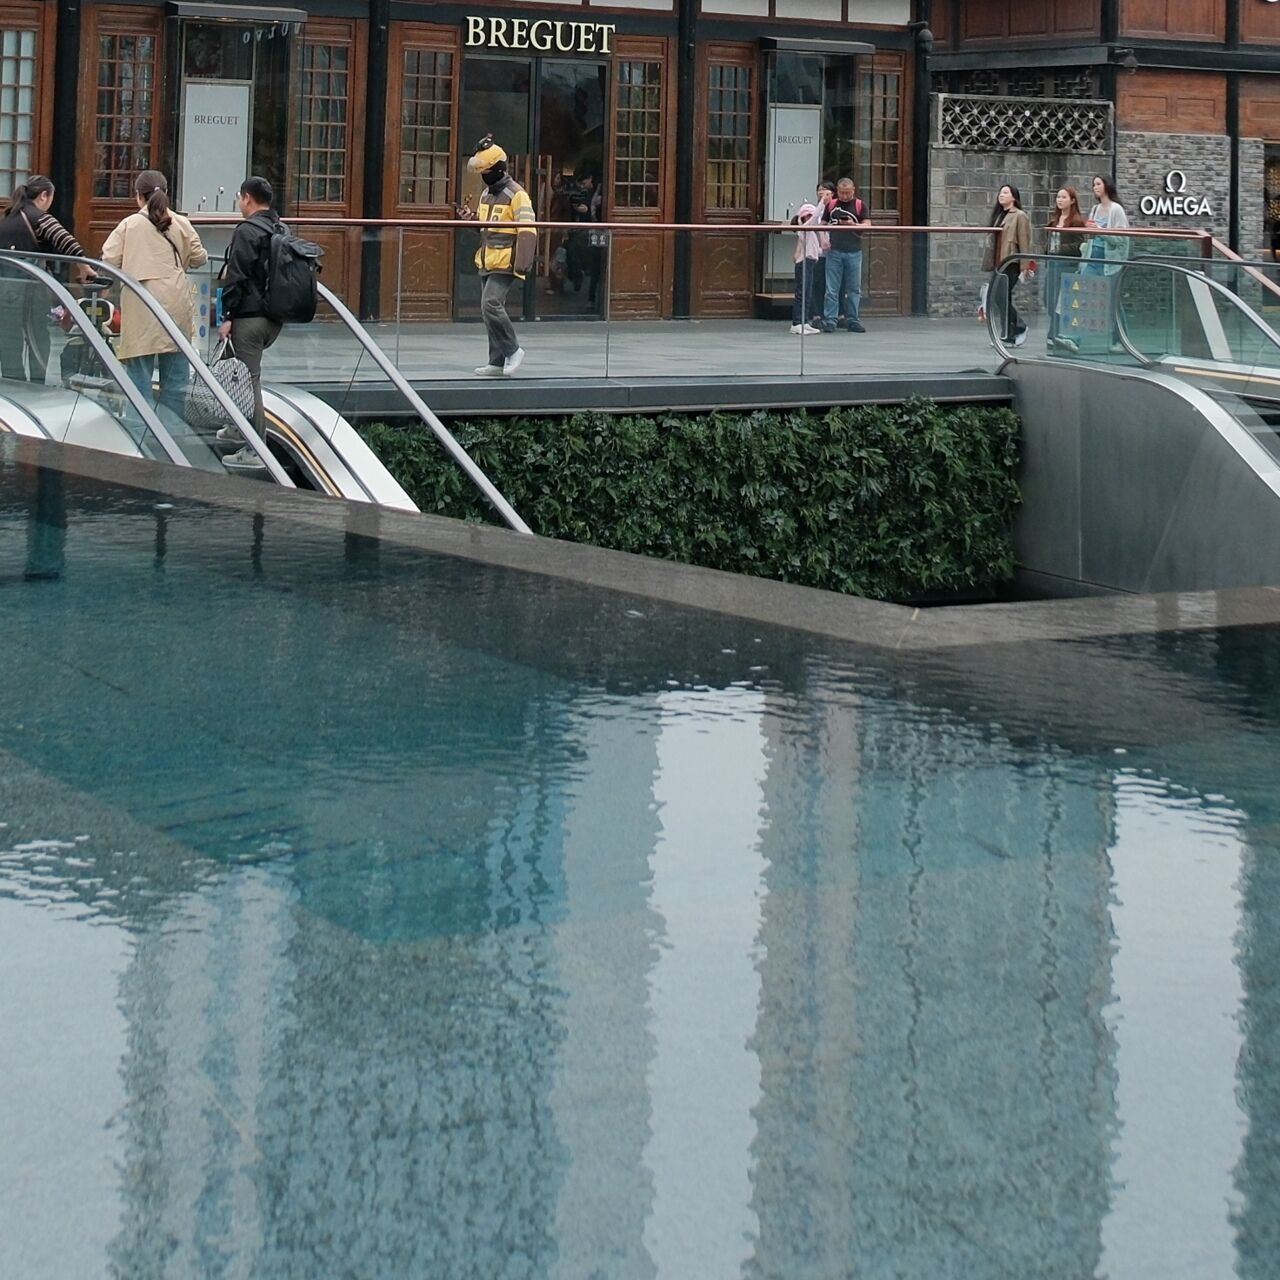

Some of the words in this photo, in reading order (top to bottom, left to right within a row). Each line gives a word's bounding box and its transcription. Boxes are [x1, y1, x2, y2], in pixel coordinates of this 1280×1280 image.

[465, 16, 616, 53] BREGUET
[194, 115, 239, 125] BREGUET
[777, 135, 813, 144] BREGUET
[1140, 195, 1213, 216] OMEGA
